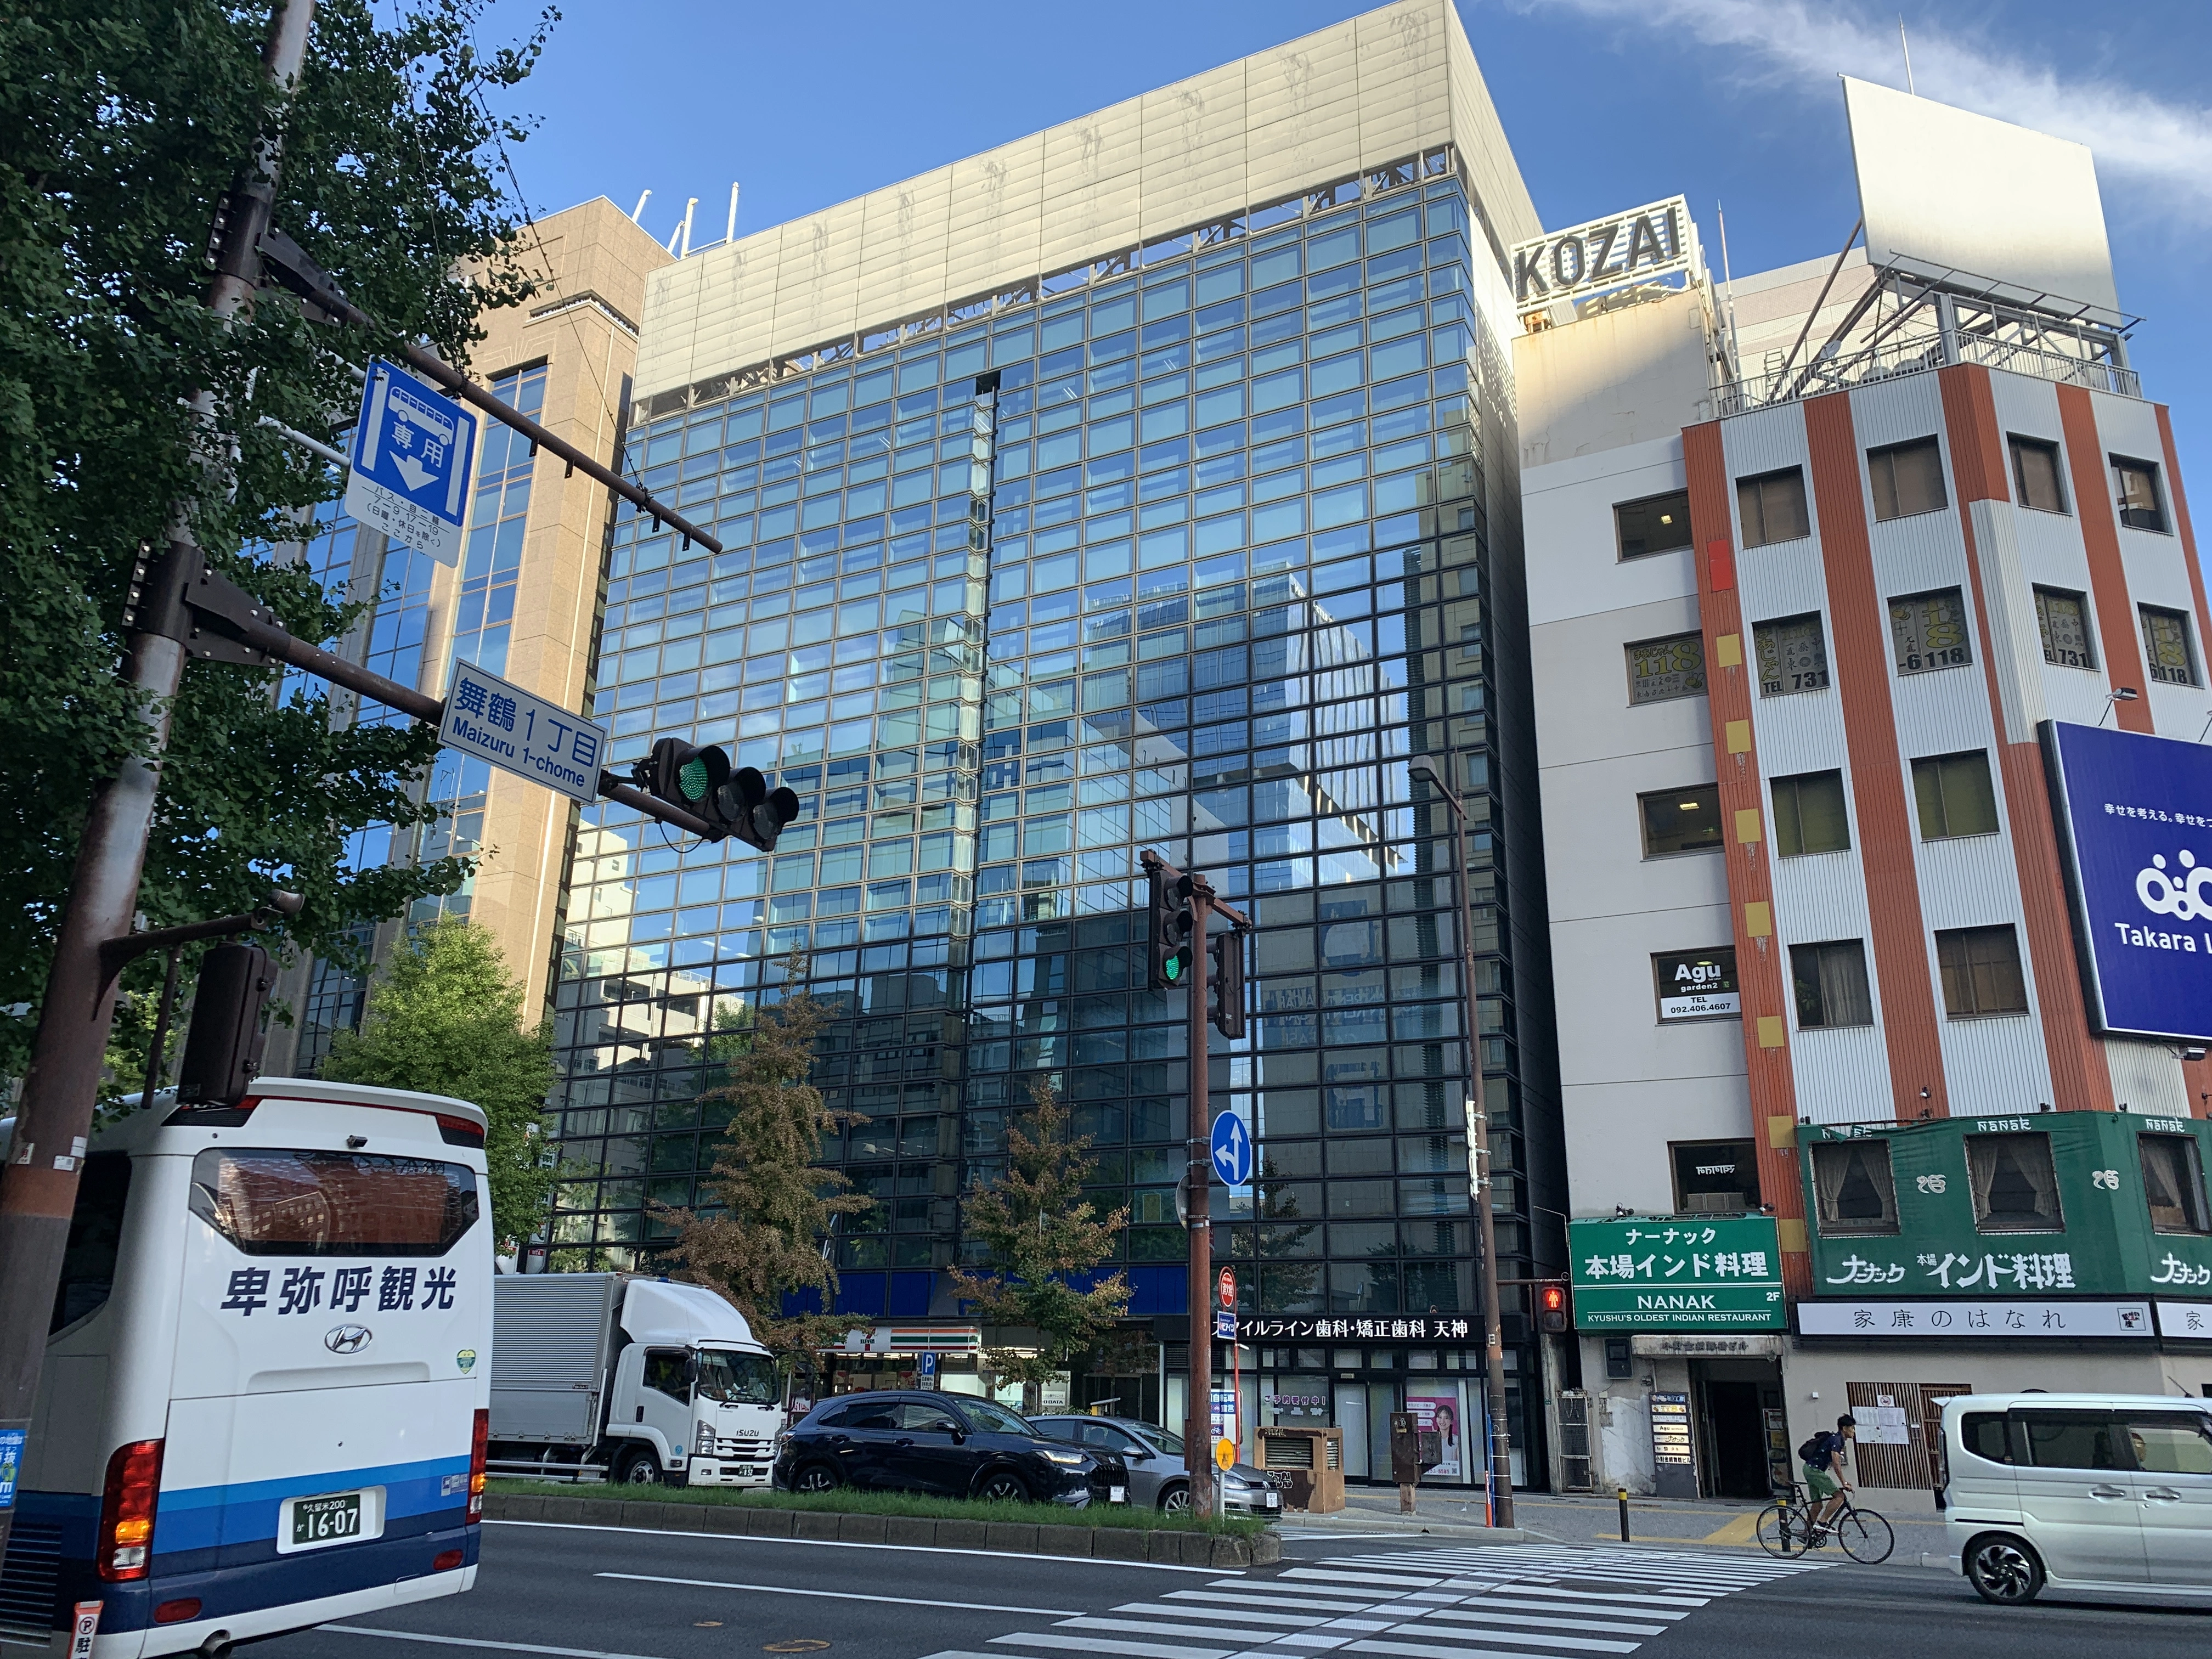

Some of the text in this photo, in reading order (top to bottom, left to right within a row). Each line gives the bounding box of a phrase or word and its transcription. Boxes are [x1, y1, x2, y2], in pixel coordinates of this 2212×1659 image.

[1517, 206, 1681, 300] KOZAI
[391, 421, 444, 468] 専用
[382, 523, 424, 549] ここから
[1635, 641, 1701, 678] 118
[1763, 670, 1827, 693] TEL 731
[454, 677, 597, 768] 舞鶴1丁目
[452, 716, 585, 787] Maizuru 1-chome
[2115, 922, 2196, 952] Takara
[1674, 964, 1721, 983] Agu
[1680, 983, 1718, 992] garden2
[1671, 1003, 1731, 1013] 092.406.4607
[1626, 1227, 1716, 1245] ナーナック
[1585, 1251, 1769, 1279] 本場インド料理
[1917, 1253, 1938, 1266] 本場
[1926, 1252, 2076, 1290] インド料理
[220, 1265, 457, 1317] 卑弥呼観光
[1637, 1291, 1780, 1310] NANAK 2F
[1211, 1319, 1469, 1339] イルライン歯科・矯正歯科 天神
[1588, 1313, 1771, 1323] KYUSHU'S OLDEST INDIAN RESTAURANT
[1854, 1308, 2067, 1329] 家康のはなれ
[2186, 1310, 2204, 1330] 家
[926, 1355, 933, 1373] P
[308, 1508, 358, 1539] 16-07
